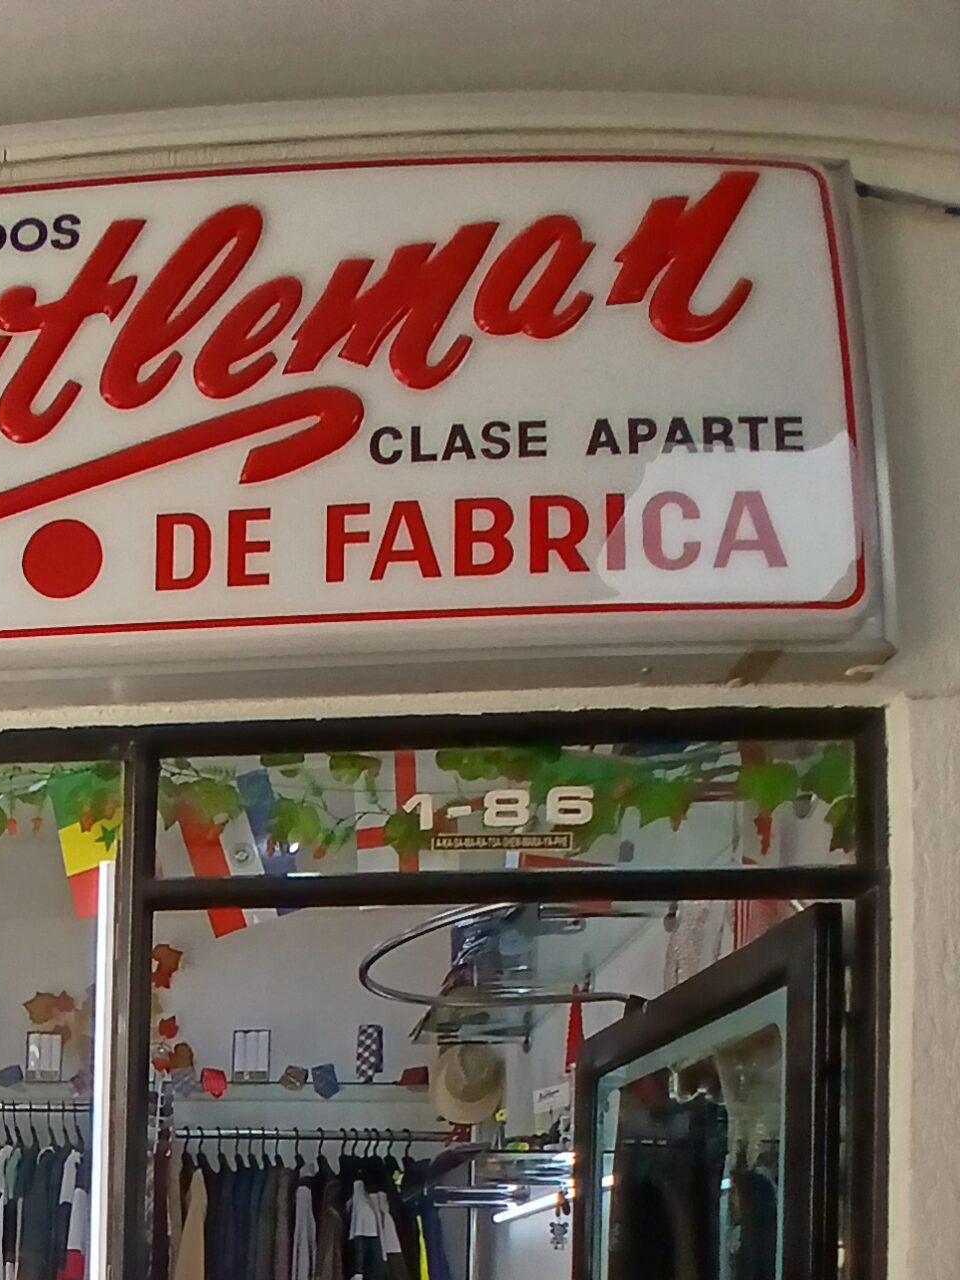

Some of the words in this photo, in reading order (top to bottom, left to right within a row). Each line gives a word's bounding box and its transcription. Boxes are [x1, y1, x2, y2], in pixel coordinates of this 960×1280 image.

[369, 420, 548, 465] CLASE
[585, 416, 805, 455] APARTE
[155, 507, 272, 591] DE
[326, 490, 788, 583] FABRICA
[402, 785, 595, 831] 1-86
